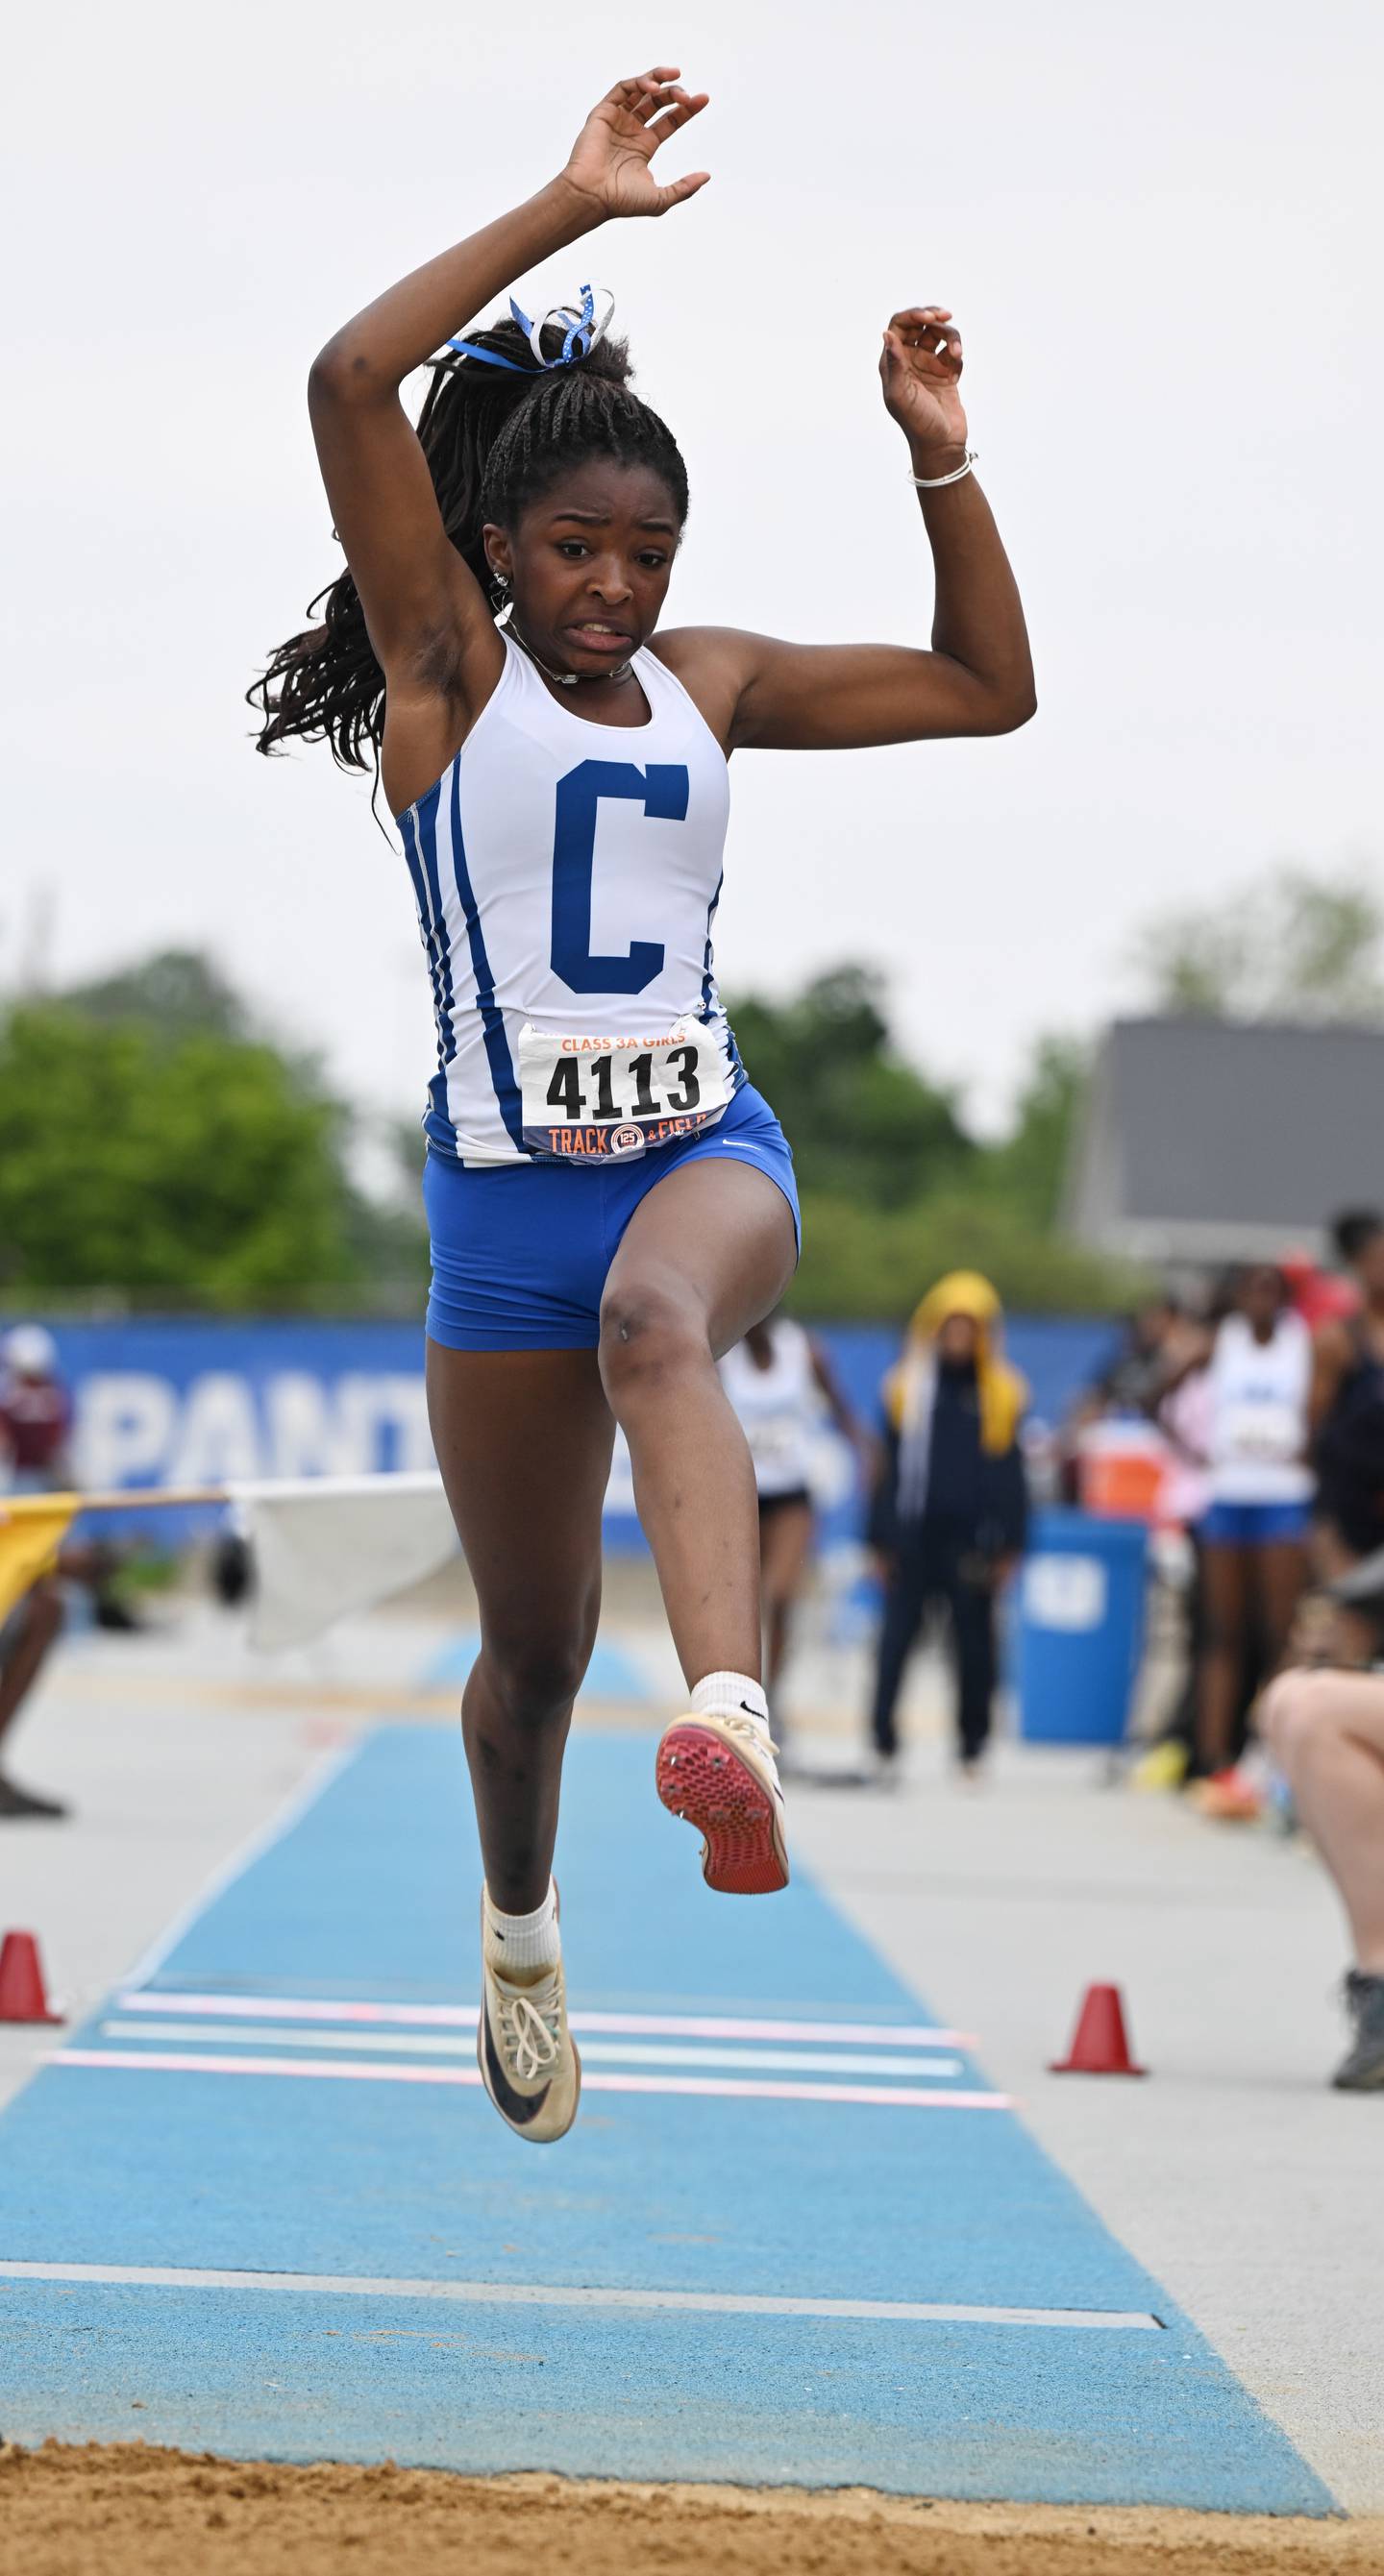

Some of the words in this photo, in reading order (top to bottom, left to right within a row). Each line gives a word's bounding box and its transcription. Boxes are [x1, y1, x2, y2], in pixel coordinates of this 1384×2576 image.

[551, 759, 689, 994] C
[562, 1038, 611, 1051] CLASS
[616, 1038, 638, 1049] 3A
[643, 1033, 685, 1047] GIRLS
[547, 1046, 701, 1119] 4113
[549, 1128, 609, 1154] TRACK
[620, 1132, 635, 1143] 125
[648, 1129, 657, 1141] &
[74, 1370, 440, 1492] PANT
